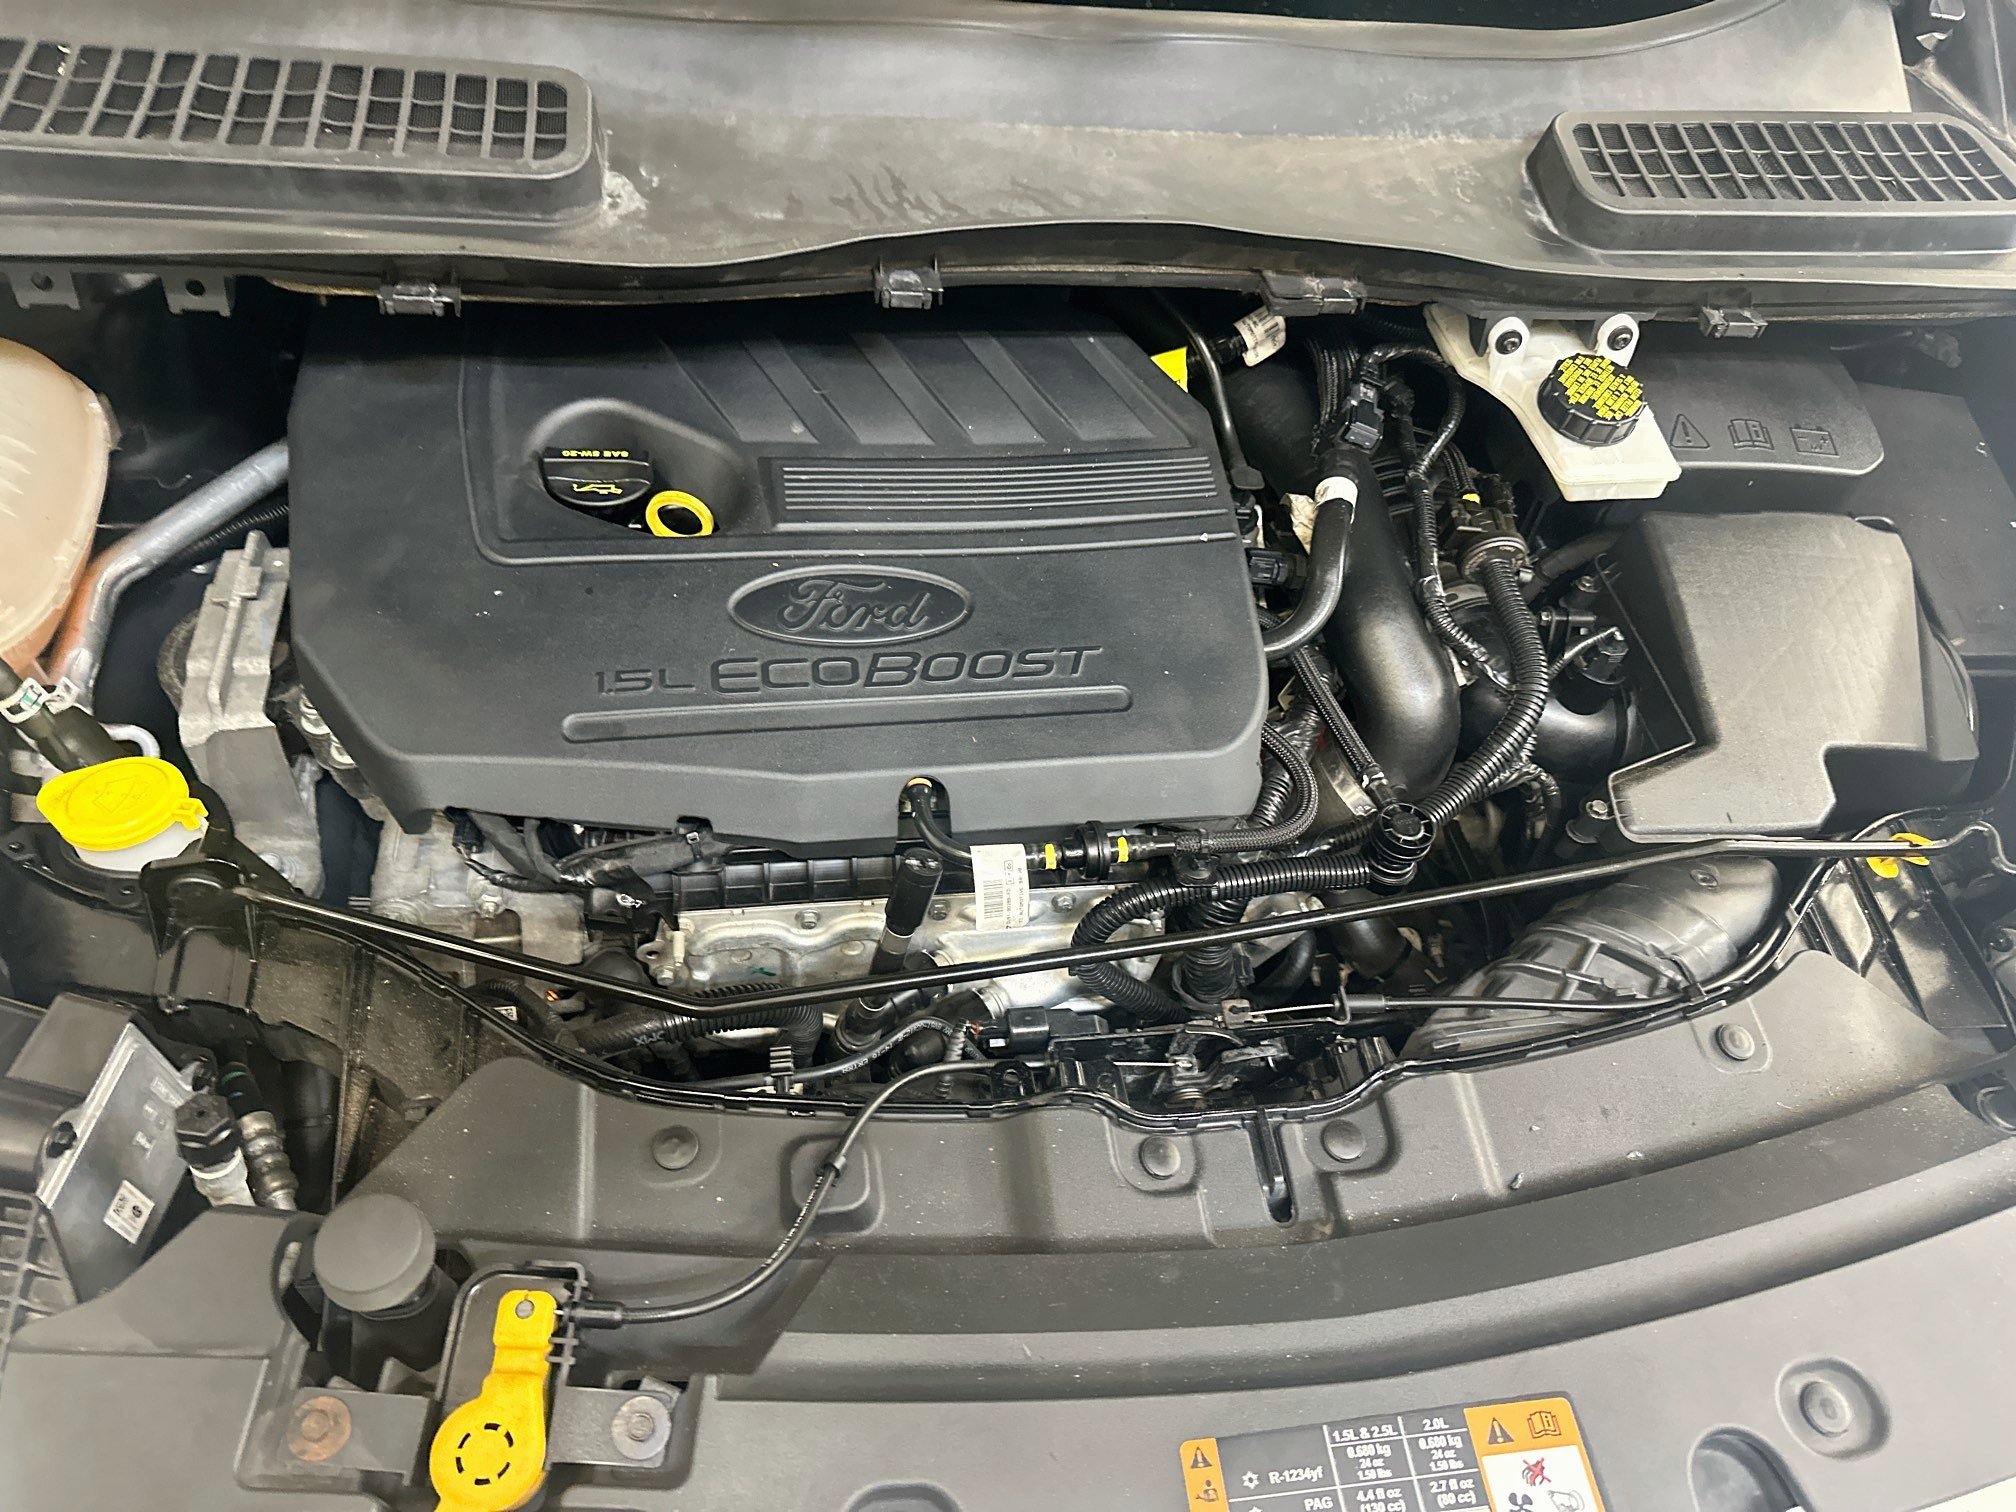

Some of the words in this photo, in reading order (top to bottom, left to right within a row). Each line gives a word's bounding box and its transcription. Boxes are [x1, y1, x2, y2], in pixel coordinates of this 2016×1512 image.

[603, 450, 629, 458] SAE
[777, 578, 931, 633] Ford
[595, 668, 697, 696] 1.5L
[1422, 1417, 1450, 1431] 2.0L
[1332, 1429, 1359, 1442] 1.5L
[1360, 1427, 1370, 1440] &
[1370, 1424, 1399, 1438] 2.5L
[1447, 1434, 1463, 1449] kg
[1376, 1443, 1392, 1457] kg
[1430, 1449, 1443, 1460] 24
[1444, 1449, 1457, 1458] oz
[1359, 1458, 1372, 1469] 24
[1372, 1458, 1385, 1467] oz
[1268, 1465, 1323, 1484] R-1234yf
[1429, 1480, 1447, 1493] 2.7
[1448, 1479, 1459, 1491] fl
[1459, 1479, 1475, 1489] oz
[1357, 1488, 1375, 1501] 4.4
[1375, 1488, 1386, 1500] fl
[1386, 1488, 1402, 1498] oz
[1457, 1490, 1477, 1505] cc)
[1304, 1496, 1334, 1511] PAG
